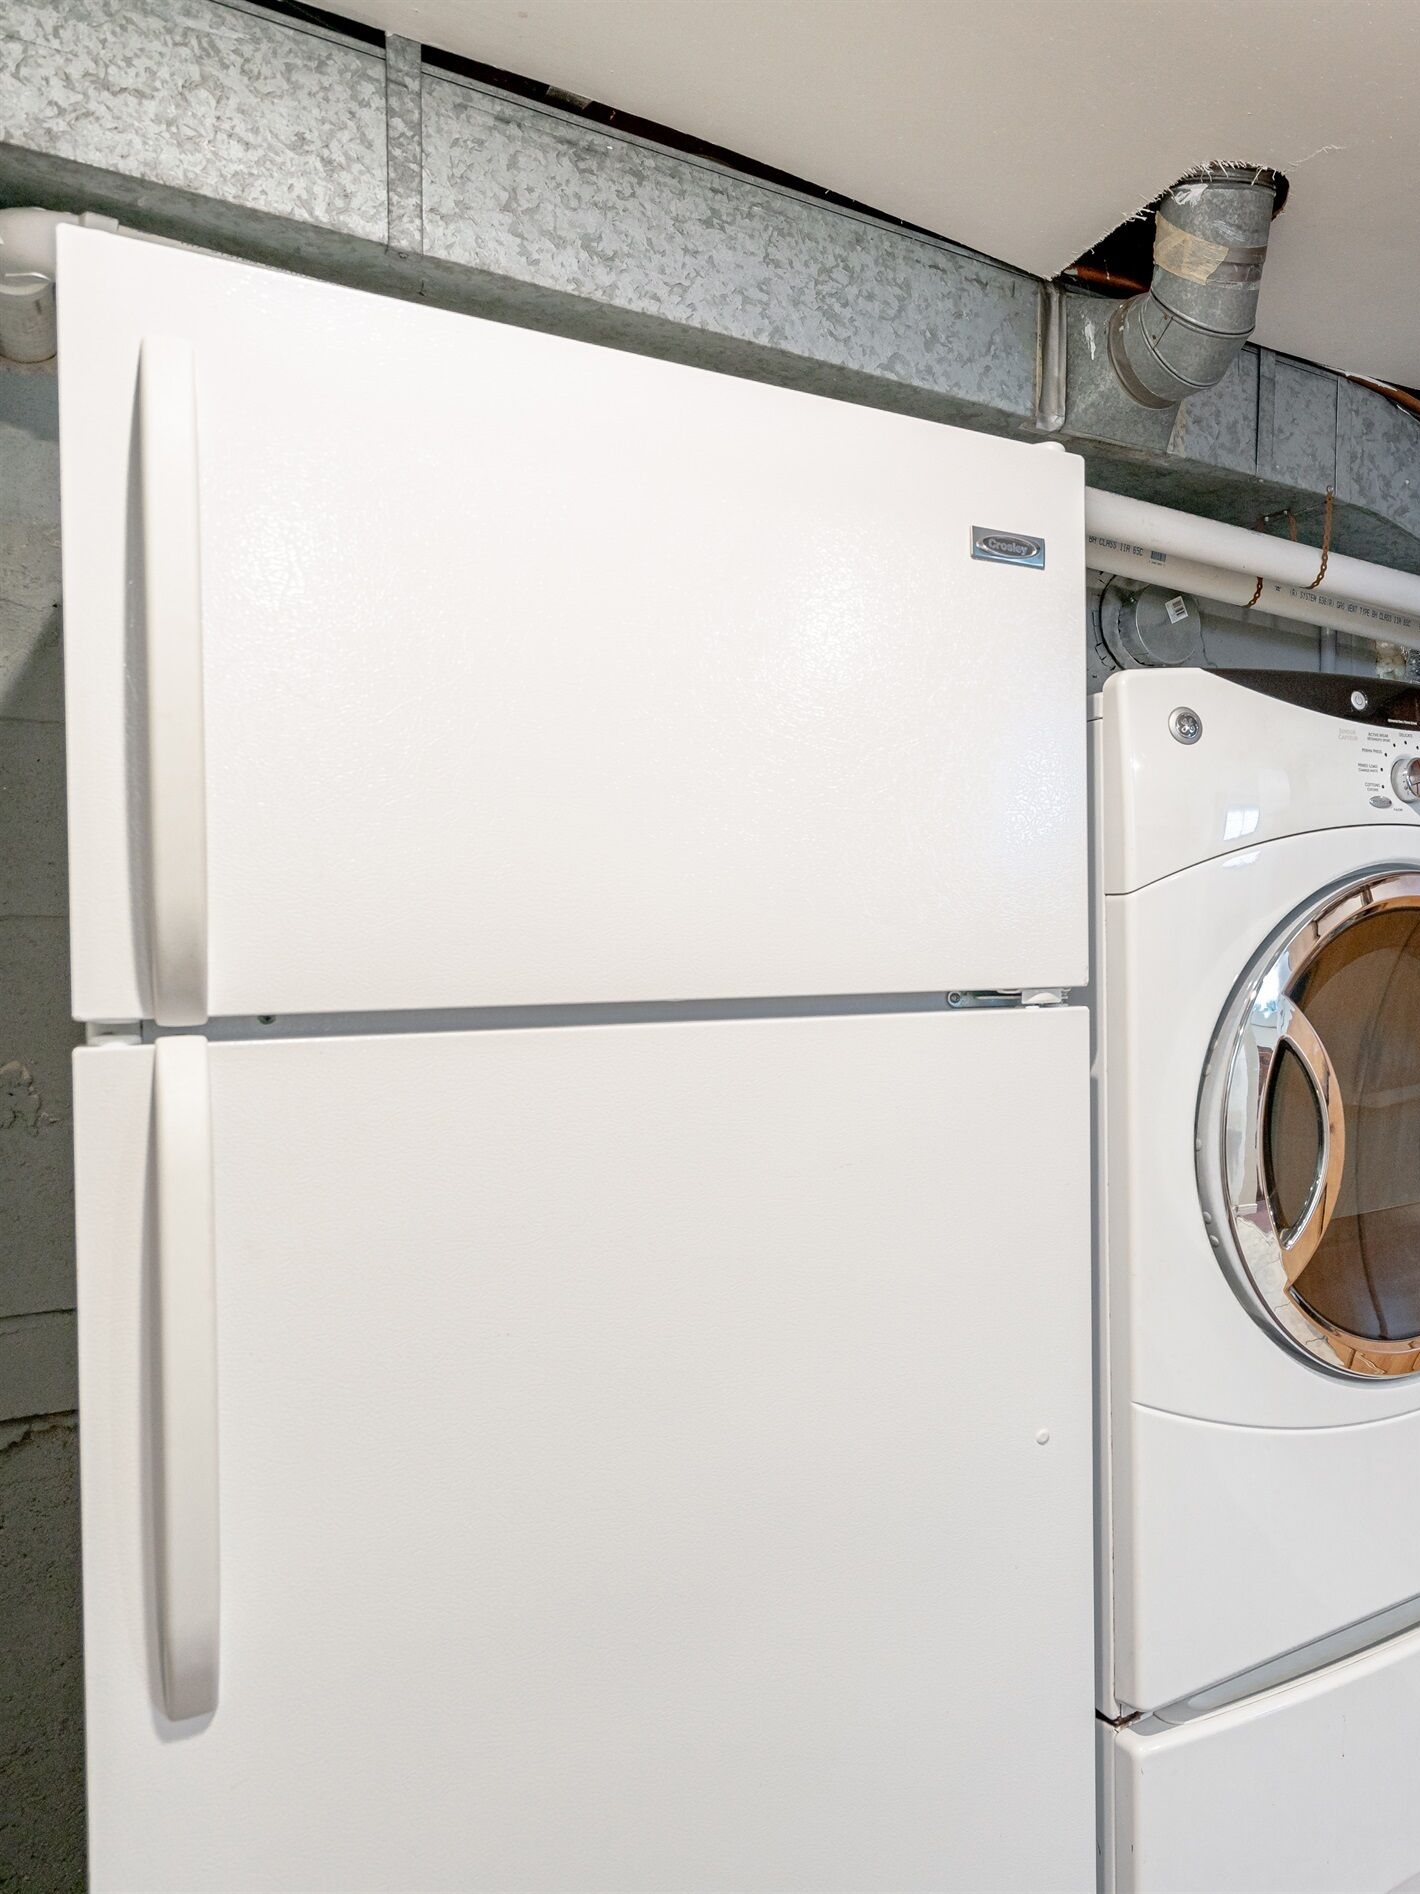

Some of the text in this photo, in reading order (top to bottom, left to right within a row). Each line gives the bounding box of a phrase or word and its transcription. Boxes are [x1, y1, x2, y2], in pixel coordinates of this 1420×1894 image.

[988, 538, 1028, 556] Crosley
[1098, 537, 1117, 549] CLASS
[1300, 591, 1317, 602] SYSTEM
[1347, 603, 1358, 613] VENT
[1359, 606, 1370, 617] TYPE
